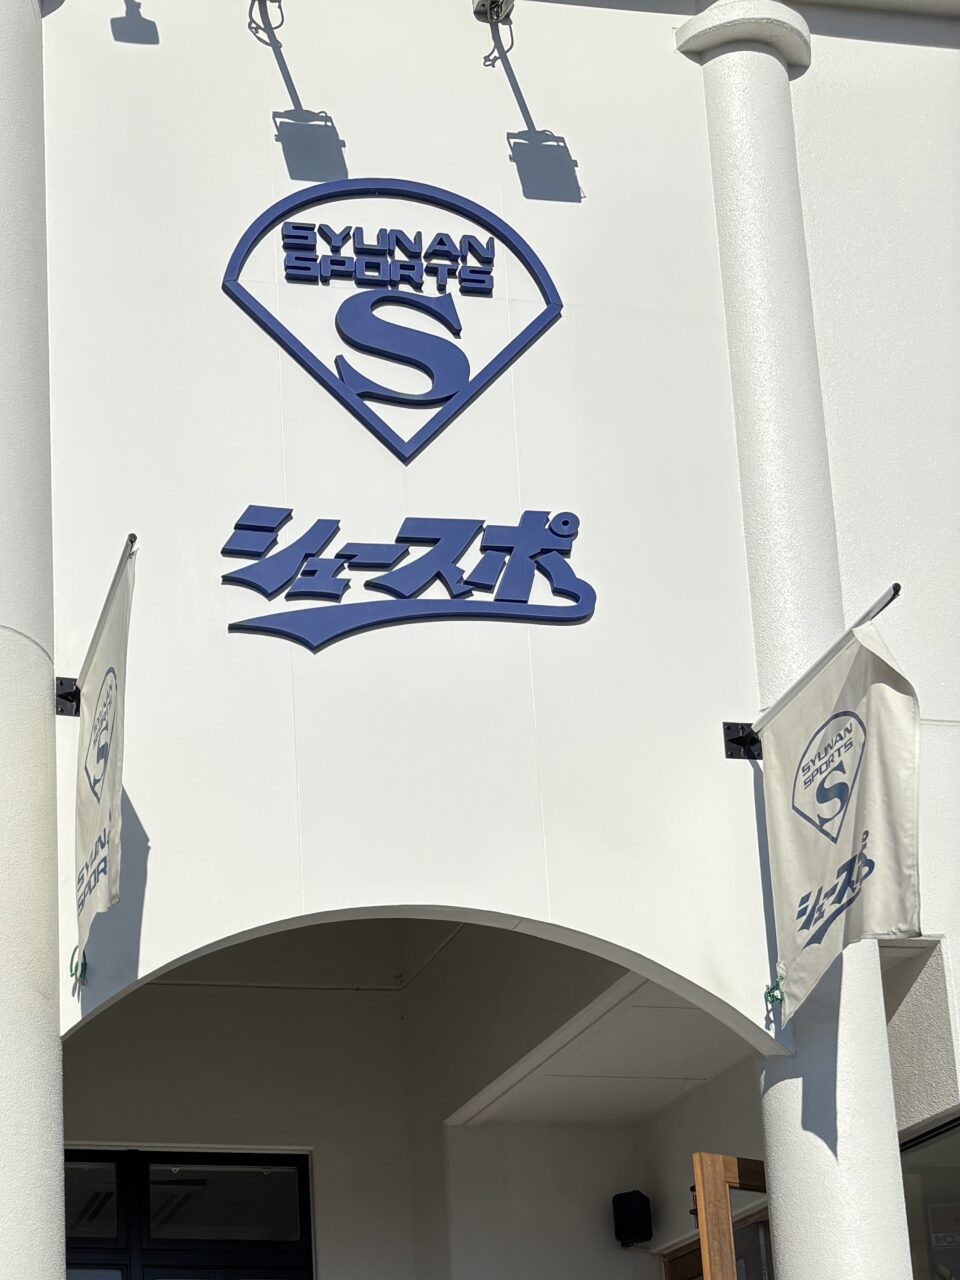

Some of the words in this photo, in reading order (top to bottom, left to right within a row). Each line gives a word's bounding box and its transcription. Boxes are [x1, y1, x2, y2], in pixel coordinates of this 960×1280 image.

[281, 222, 495, 264] SYUNAN
[284, 253, 494, 298] SPORTS
[334, 289, 470, 410] S
[221, 504, 596, 606] シュースポ
[801, 722, 854, 777] SYUNAN
[803, 738, 854, 791] SPORTS
[816, 760, 848, 830] S
[77, 828, 107, 892] SYUN
[77, 856, 108, 919] SPOR
